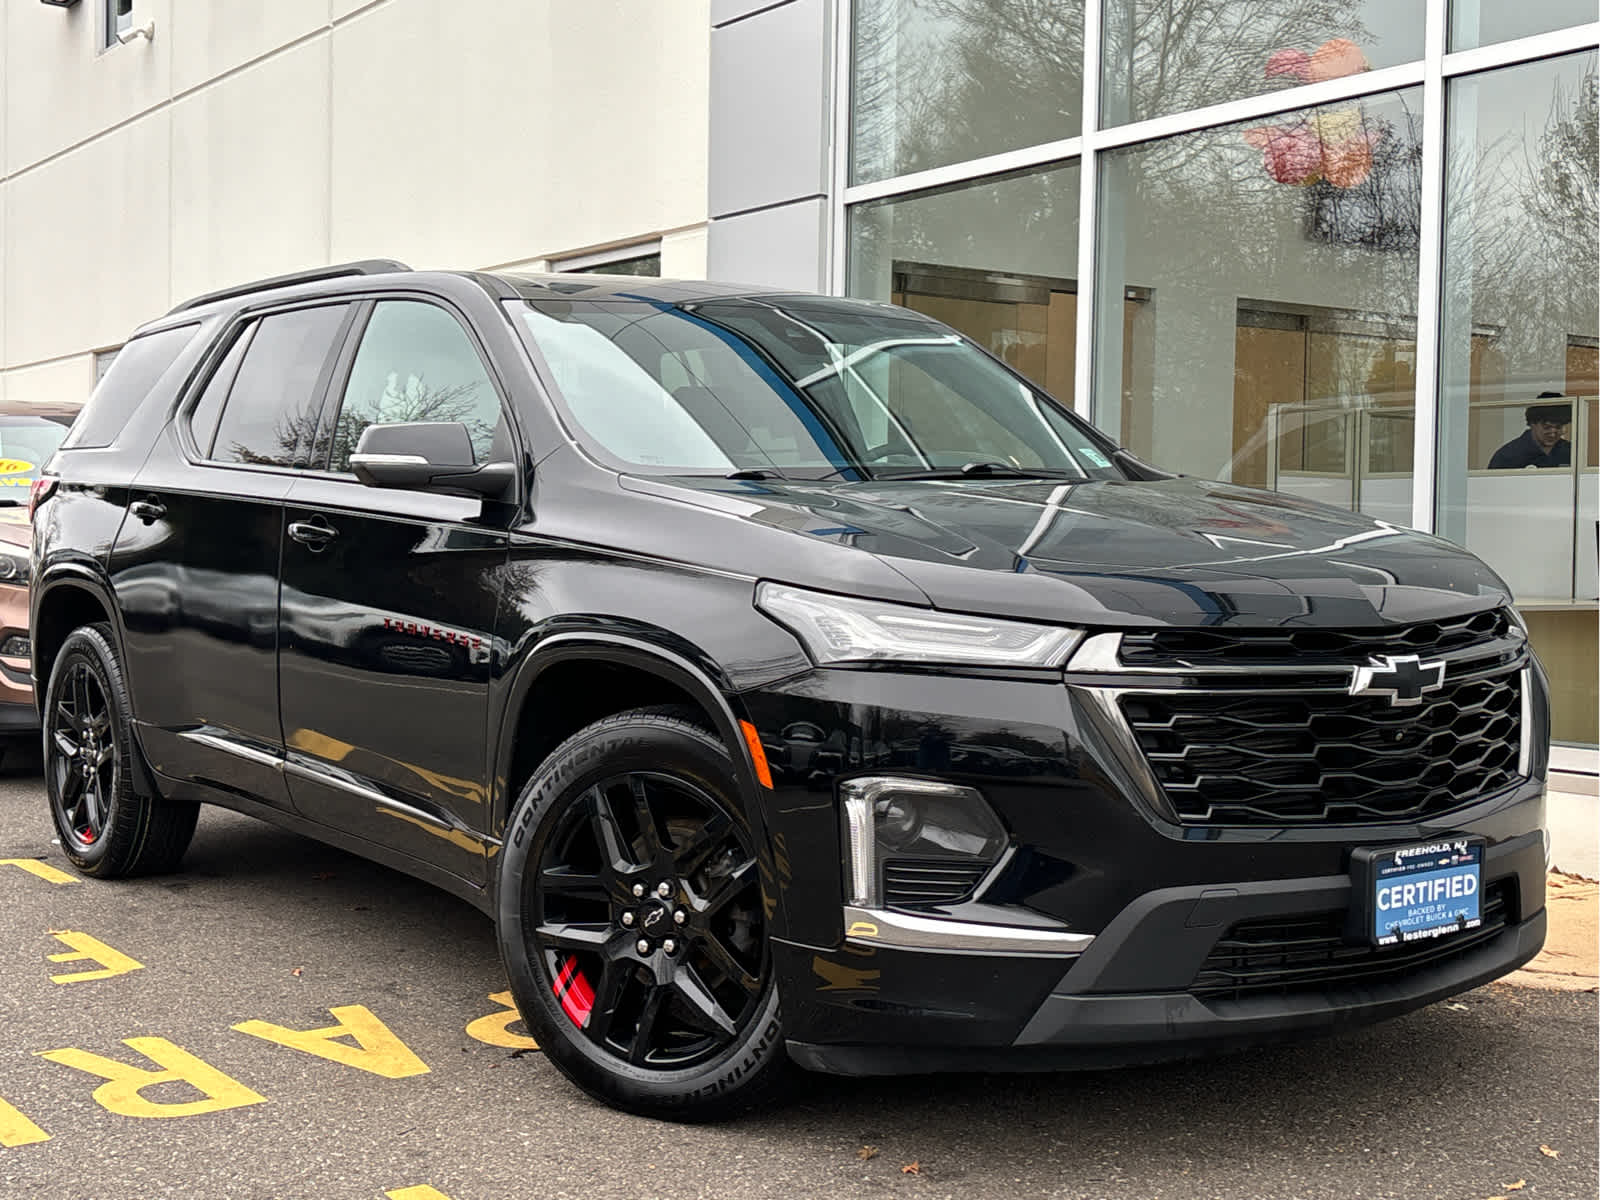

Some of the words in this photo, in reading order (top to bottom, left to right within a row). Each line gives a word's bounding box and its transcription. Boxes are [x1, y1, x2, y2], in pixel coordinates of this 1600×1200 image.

[384, 617, 481, 649] TRAVERSE
[1395, 843, 1452, 858] FREEHOLD,
[1454, 840, 1468, 850] NJ
[1377, 873, 1477, 911] CERTIFIED
[1407, 905, 1435, 917] BACKED
[1436, 903, 1447, 912] BY
[1384, 916, 1424, 930] CHEVROLET
[1425, 911, 1447, 922] BUICK
